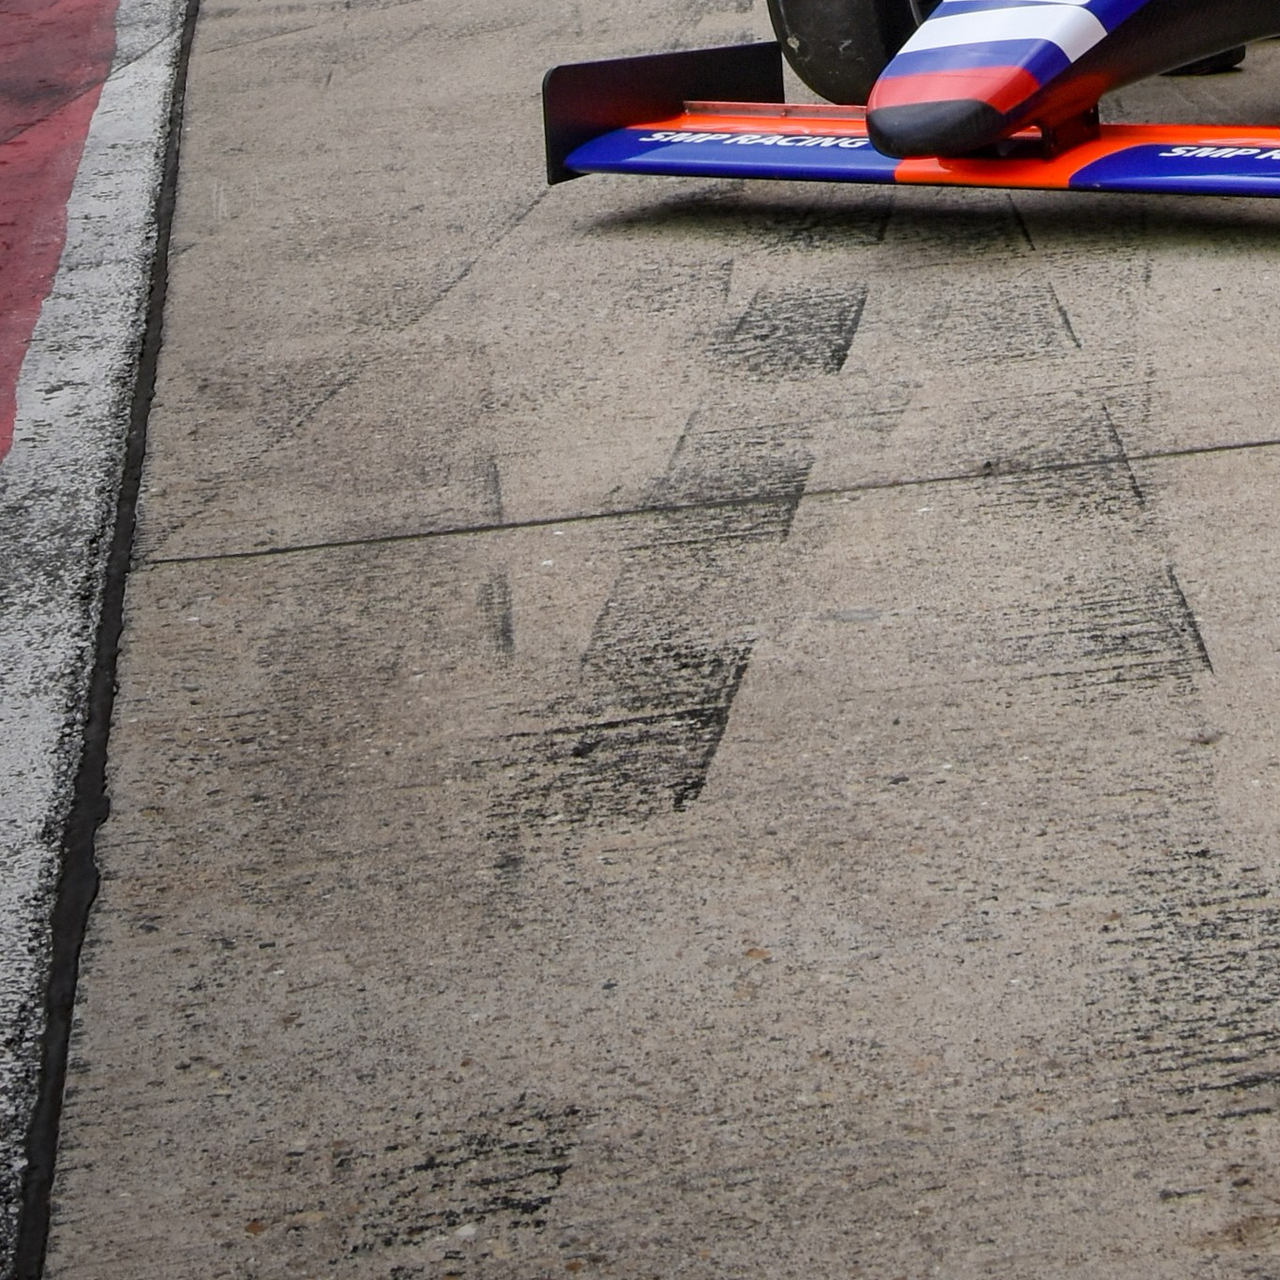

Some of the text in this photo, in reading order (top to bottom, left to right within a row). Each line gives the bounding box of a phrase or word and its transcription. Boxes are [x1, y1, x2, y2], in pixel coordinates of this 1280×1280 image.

[639, 131, 869, 149] SMP RACING
[1159, 146, 1262, 160] SMP
